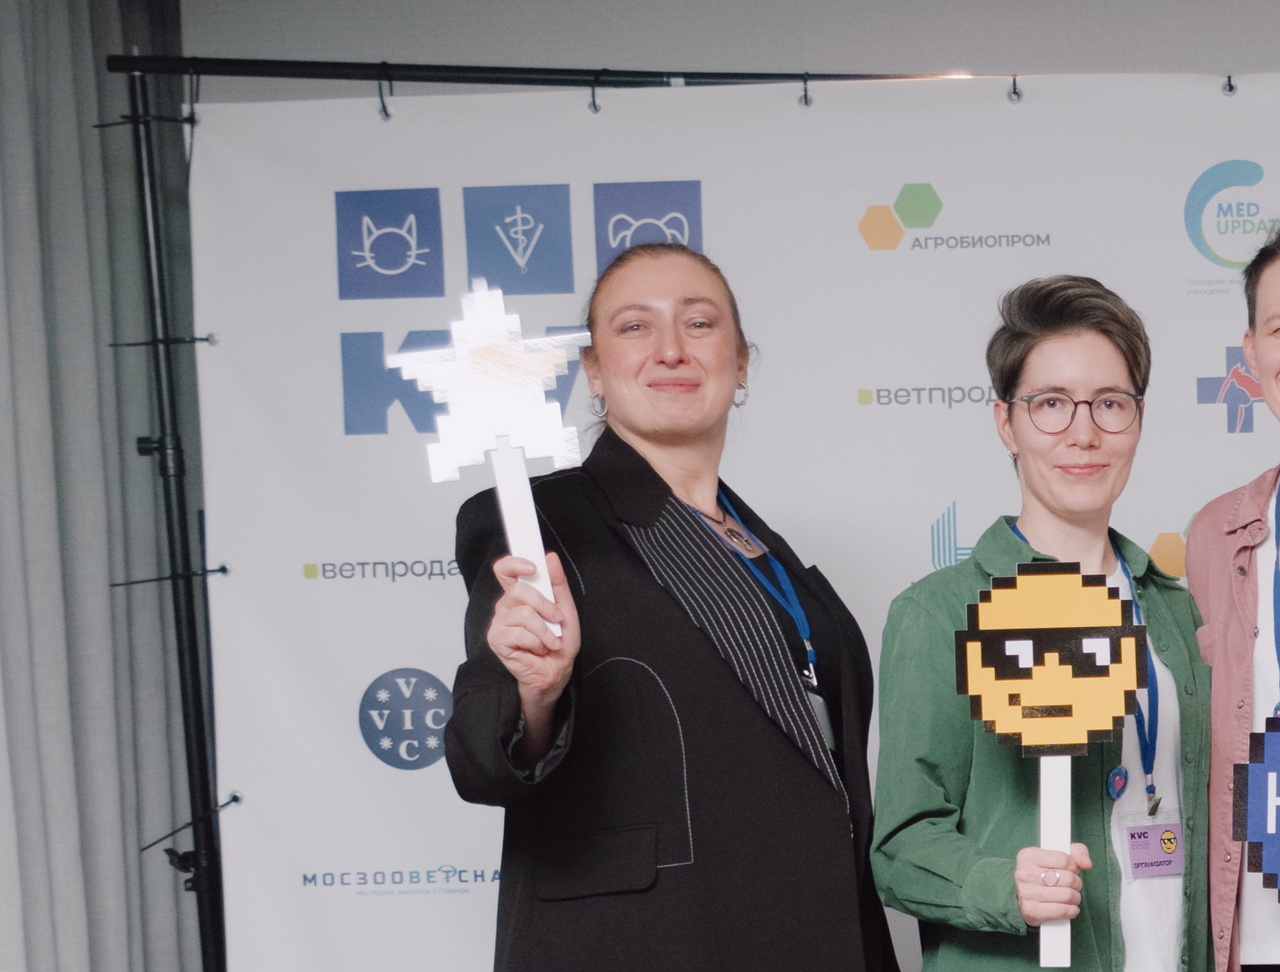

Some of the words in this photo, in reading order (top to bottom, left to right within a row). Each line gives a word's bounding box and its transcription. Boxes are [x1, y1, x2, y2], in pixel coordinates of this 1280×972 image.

[1216, 202, 1260, 218] MED
[911, 234, 1050, 250] АГРОБИОПРОМ
[1130, 831, 1149, 840] KVC
[1133, 859, 1173, 869] ОРГАНИЗАТОР
